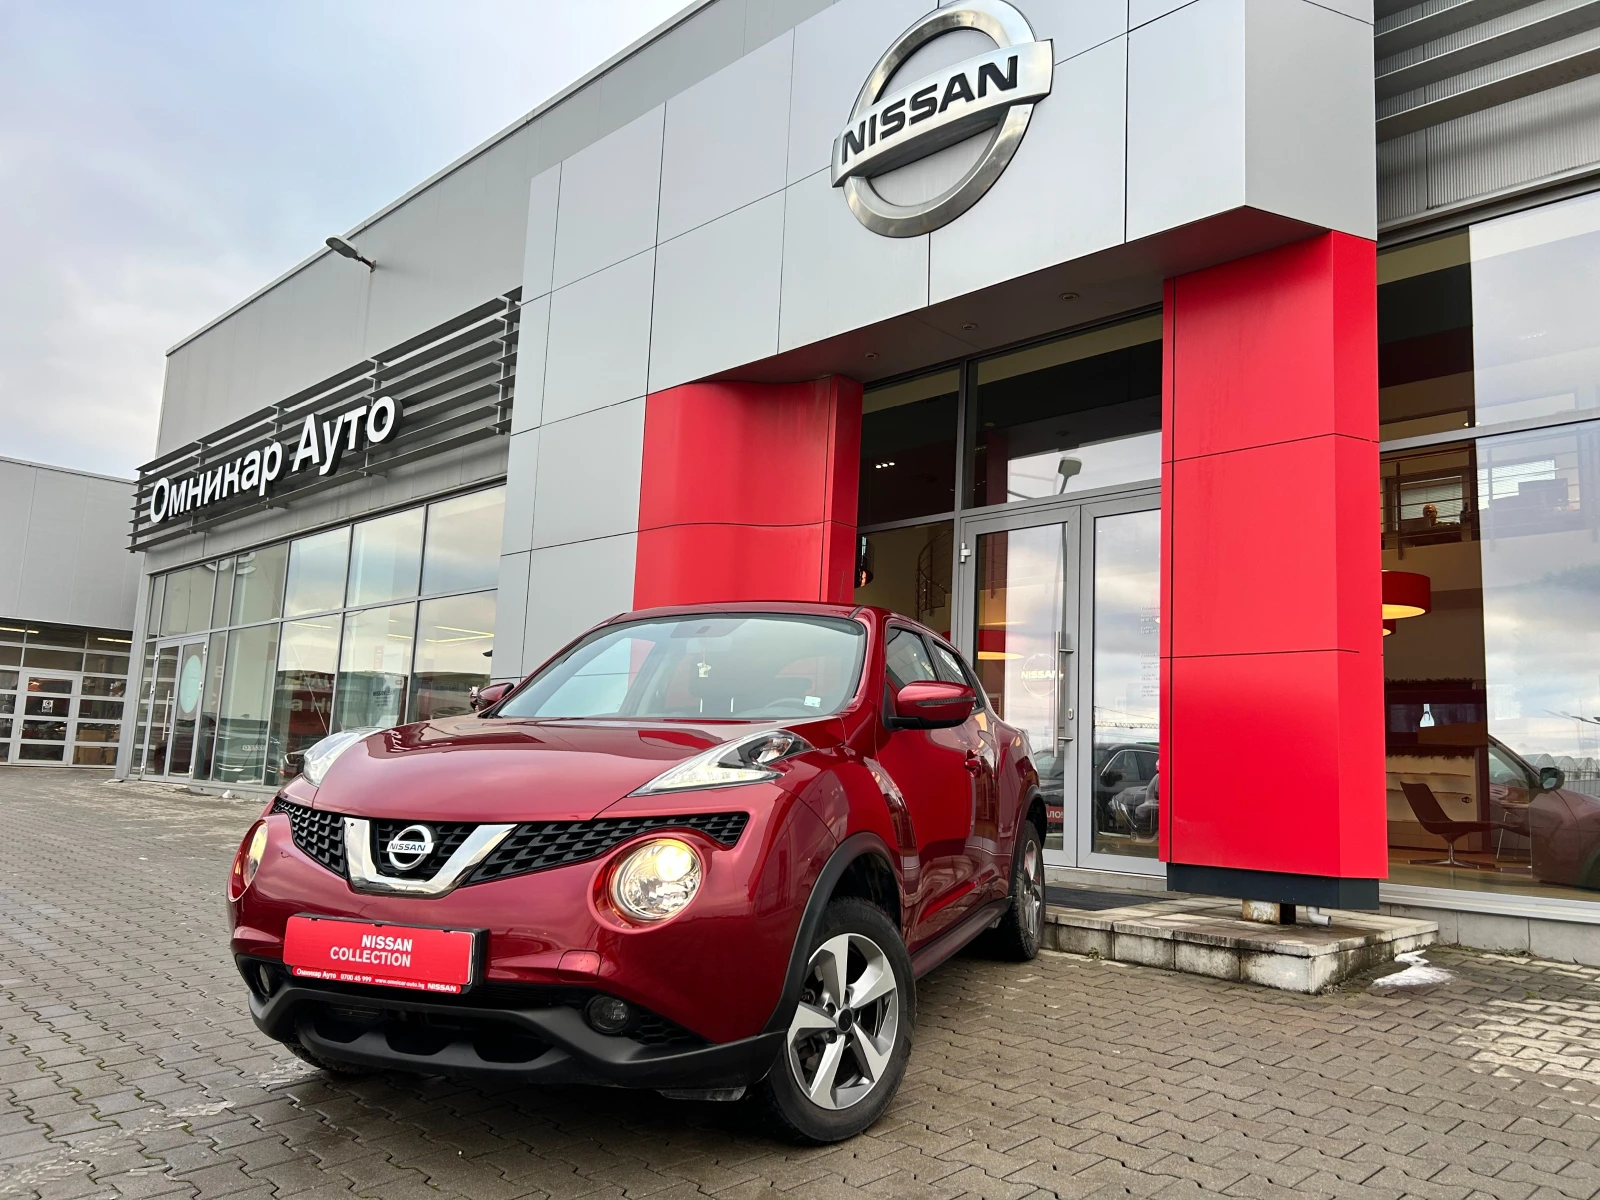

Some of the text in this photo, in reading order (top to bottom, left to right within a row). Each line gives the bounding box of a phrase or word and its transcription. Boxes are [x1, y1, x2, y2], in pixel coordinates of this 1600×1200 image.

[842, 55, 1018, 165] NISSAN
[150, 395, 397, 524] Омникар Ауто
[390, 843, 426, 851] NISSAN
[361, 934, 413, 952] NISSAN
[330, 947, 411, 968] COLLECTION
[296, 968, 321, 978] Омникар
[322, 971, 337, 980] Ауто
[340, 973, 354, 981] 0700
[361, 975, 372, 983] 999
[427, 983, 457, 992] NISSAN
